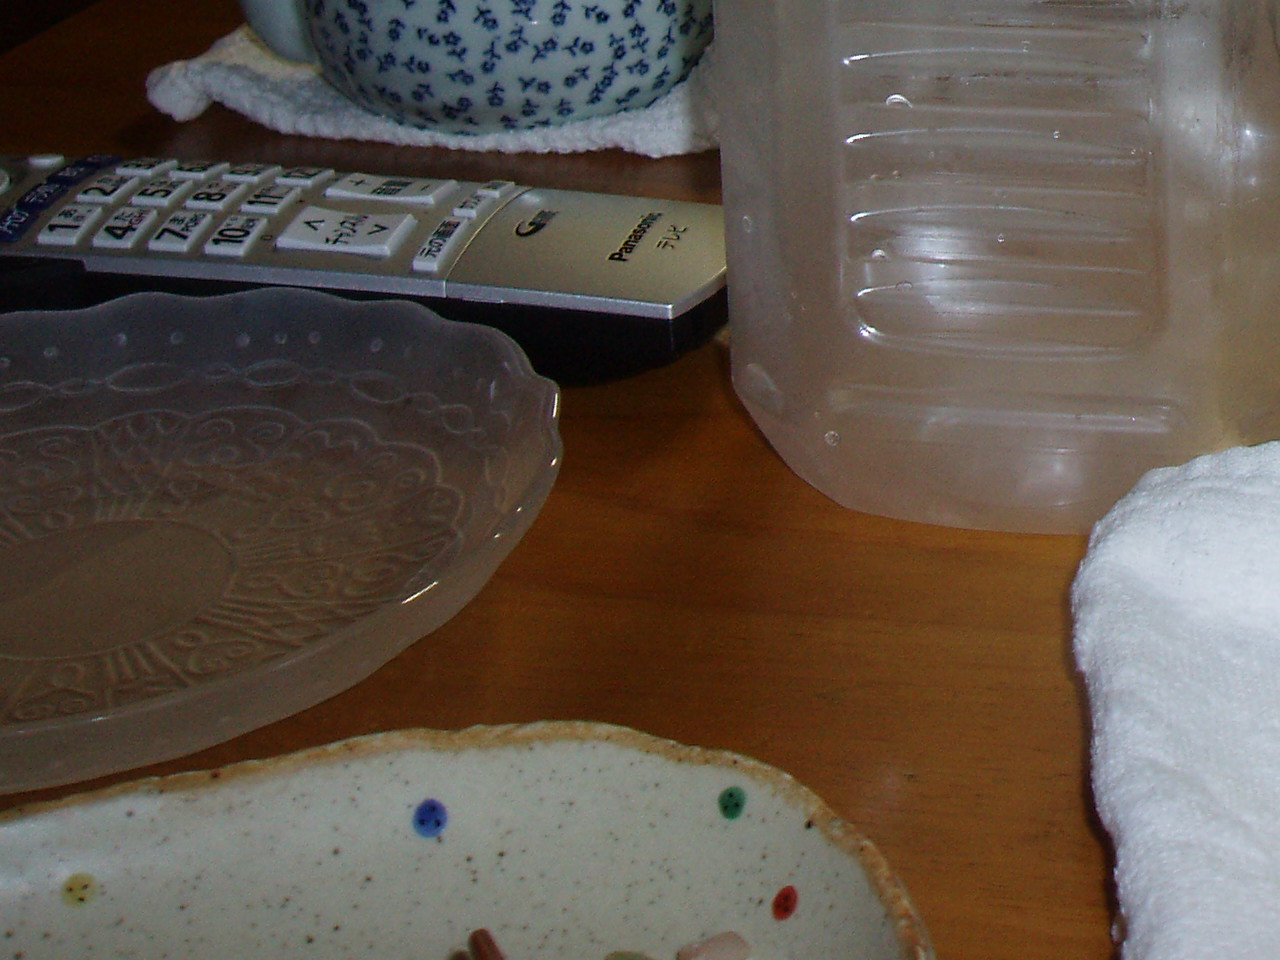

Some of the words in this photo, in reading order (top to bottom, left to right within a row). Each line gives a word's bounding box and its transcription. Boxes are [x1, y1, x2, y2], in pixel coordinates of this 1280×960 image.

[192, 191, 227, 202] 8
[104, 224, 137, 240] 4
[153, 227, 189, 241] 7
[211, 227, 251, 245] 10
[608, 211, 664, 262] Panasonic
[656, 224, 689, 250] テレビ
